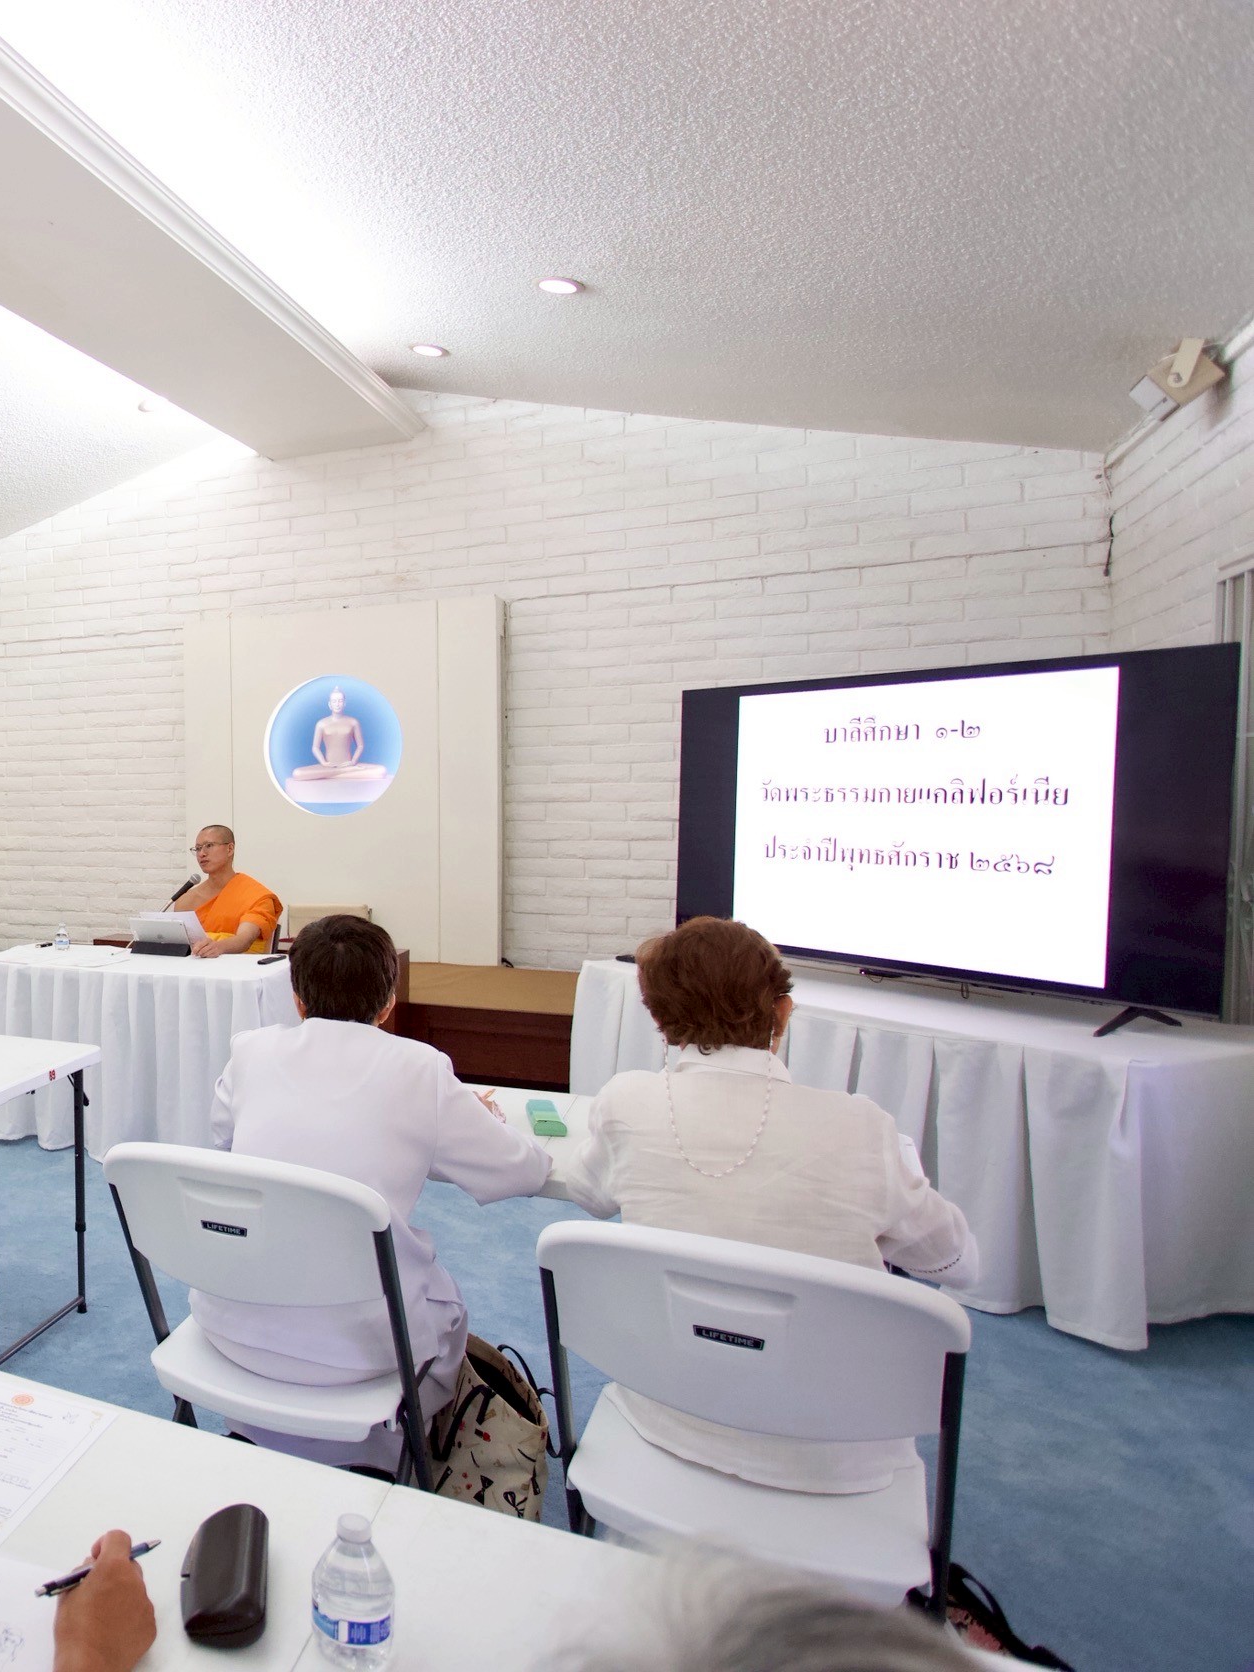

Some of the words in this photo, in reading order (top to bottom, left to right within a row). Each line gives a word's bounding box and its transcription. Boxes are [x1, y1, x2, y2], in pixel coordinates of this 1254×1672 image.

[824, 717, 920, 743] บาลีศึกษา
[935, 719, 981, 739] ๑-๒
[761, 773, 1069, 806] วัดพระธรรมกายแคลิฟอร์เนีย
[765, 835, 960, 872] ประจำปีพุทธศักราช
[970, 852, 1055, 875] ๒๕๖๘
[206, 1223, 241, 1235] LIFETIME
[701, 1329, 755, 1346] LIFETIME
